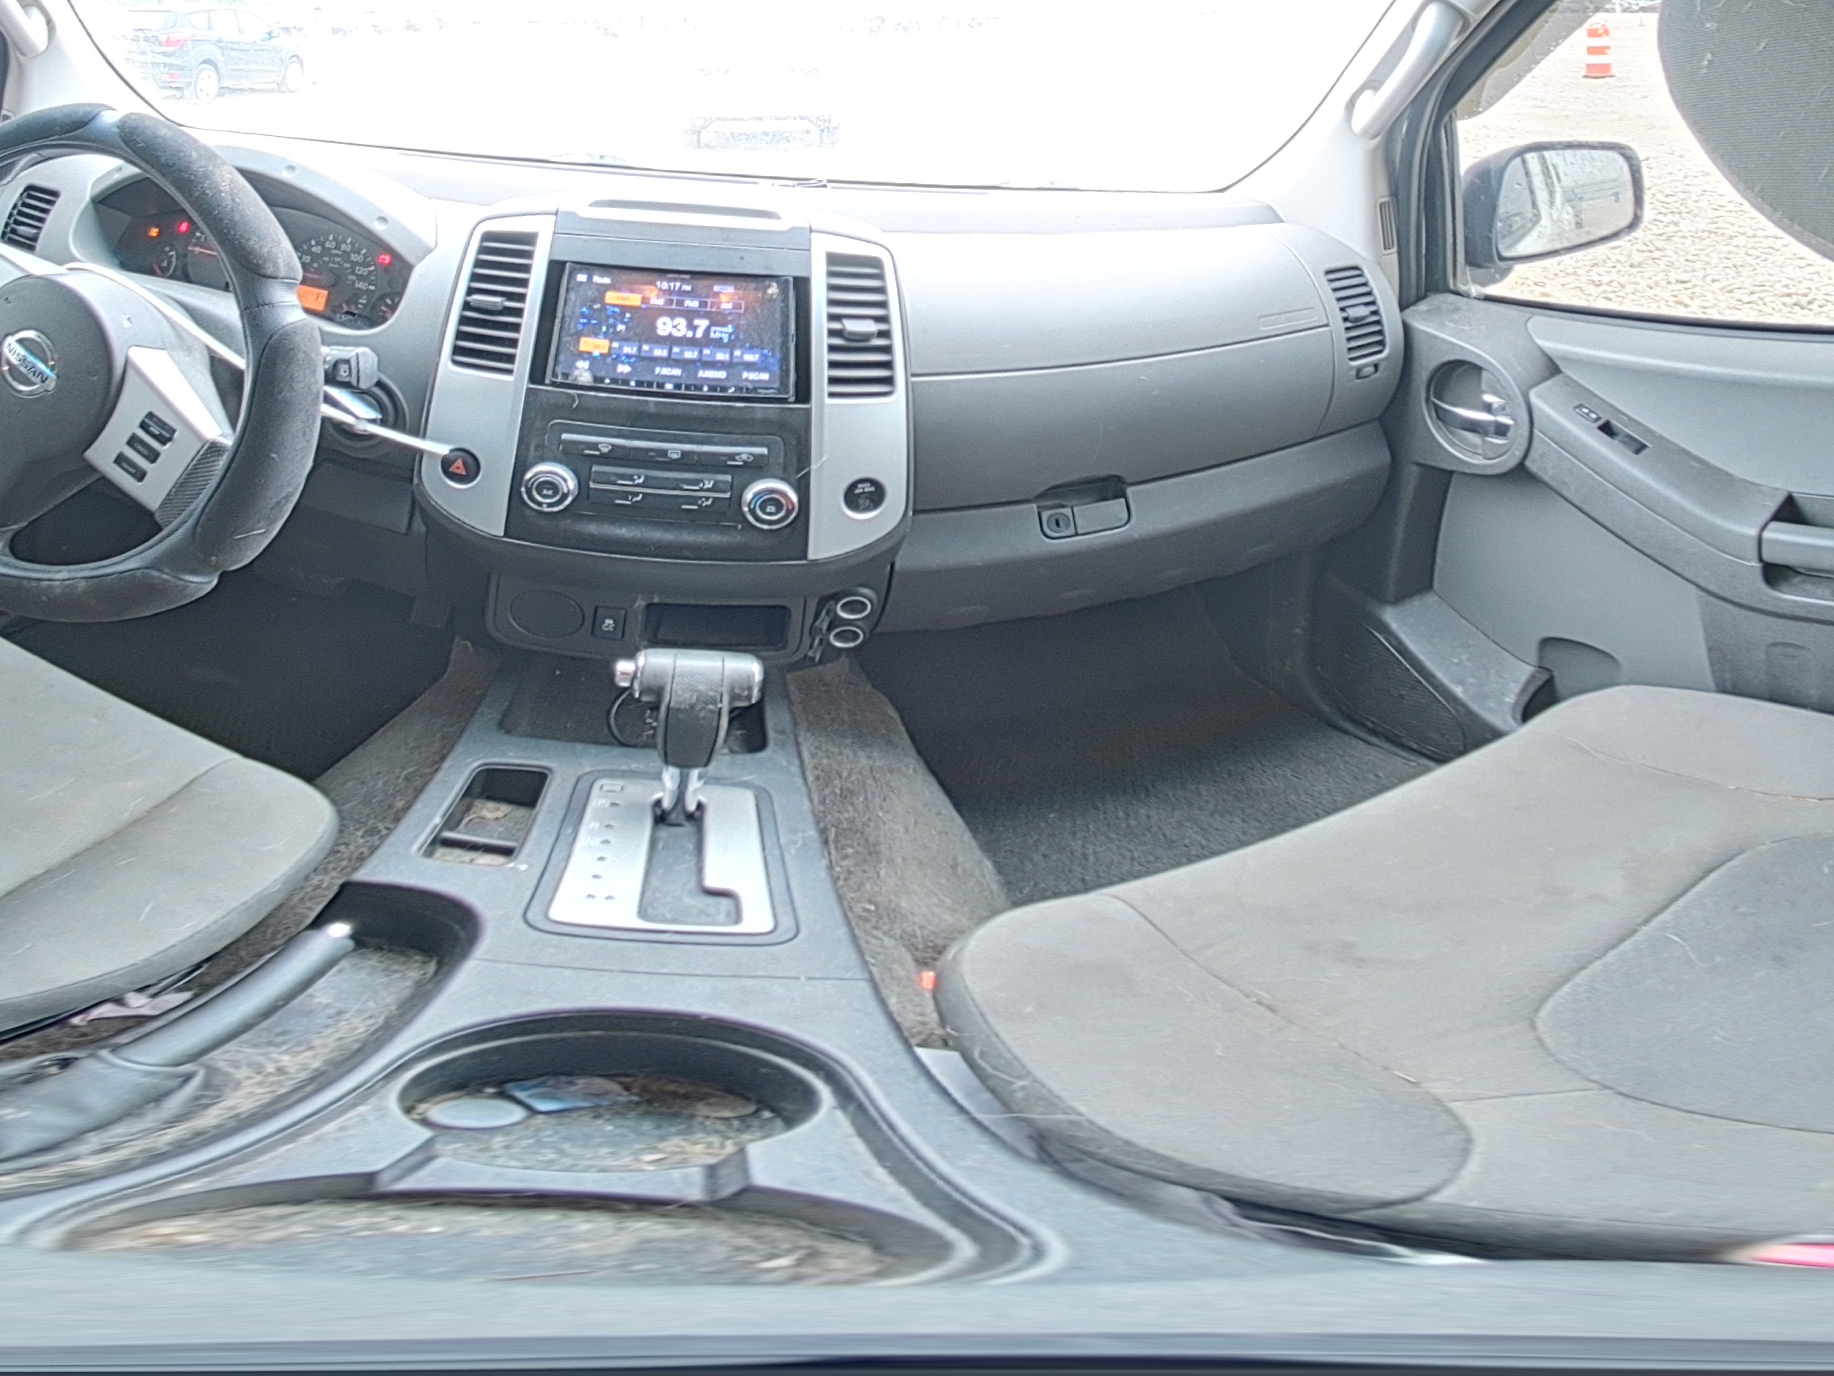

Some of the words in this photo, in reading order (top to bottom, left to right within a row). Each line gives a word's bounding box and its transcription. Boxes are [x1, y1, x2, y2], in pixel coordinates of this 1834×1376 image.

[325, 240, 336, 249] 60
[341, 243, 351, 252] 80
[311, 245, 322, 254] 40
[350, 253, 364, 263] 100
[355, 266, 368, 275] 120
[355, 281, 368, 290] 140
[656, 280, 681, 291] 10:17
[656, 316, 709, 339] 93.7
[6, 342, 48, 384] NISSAN
